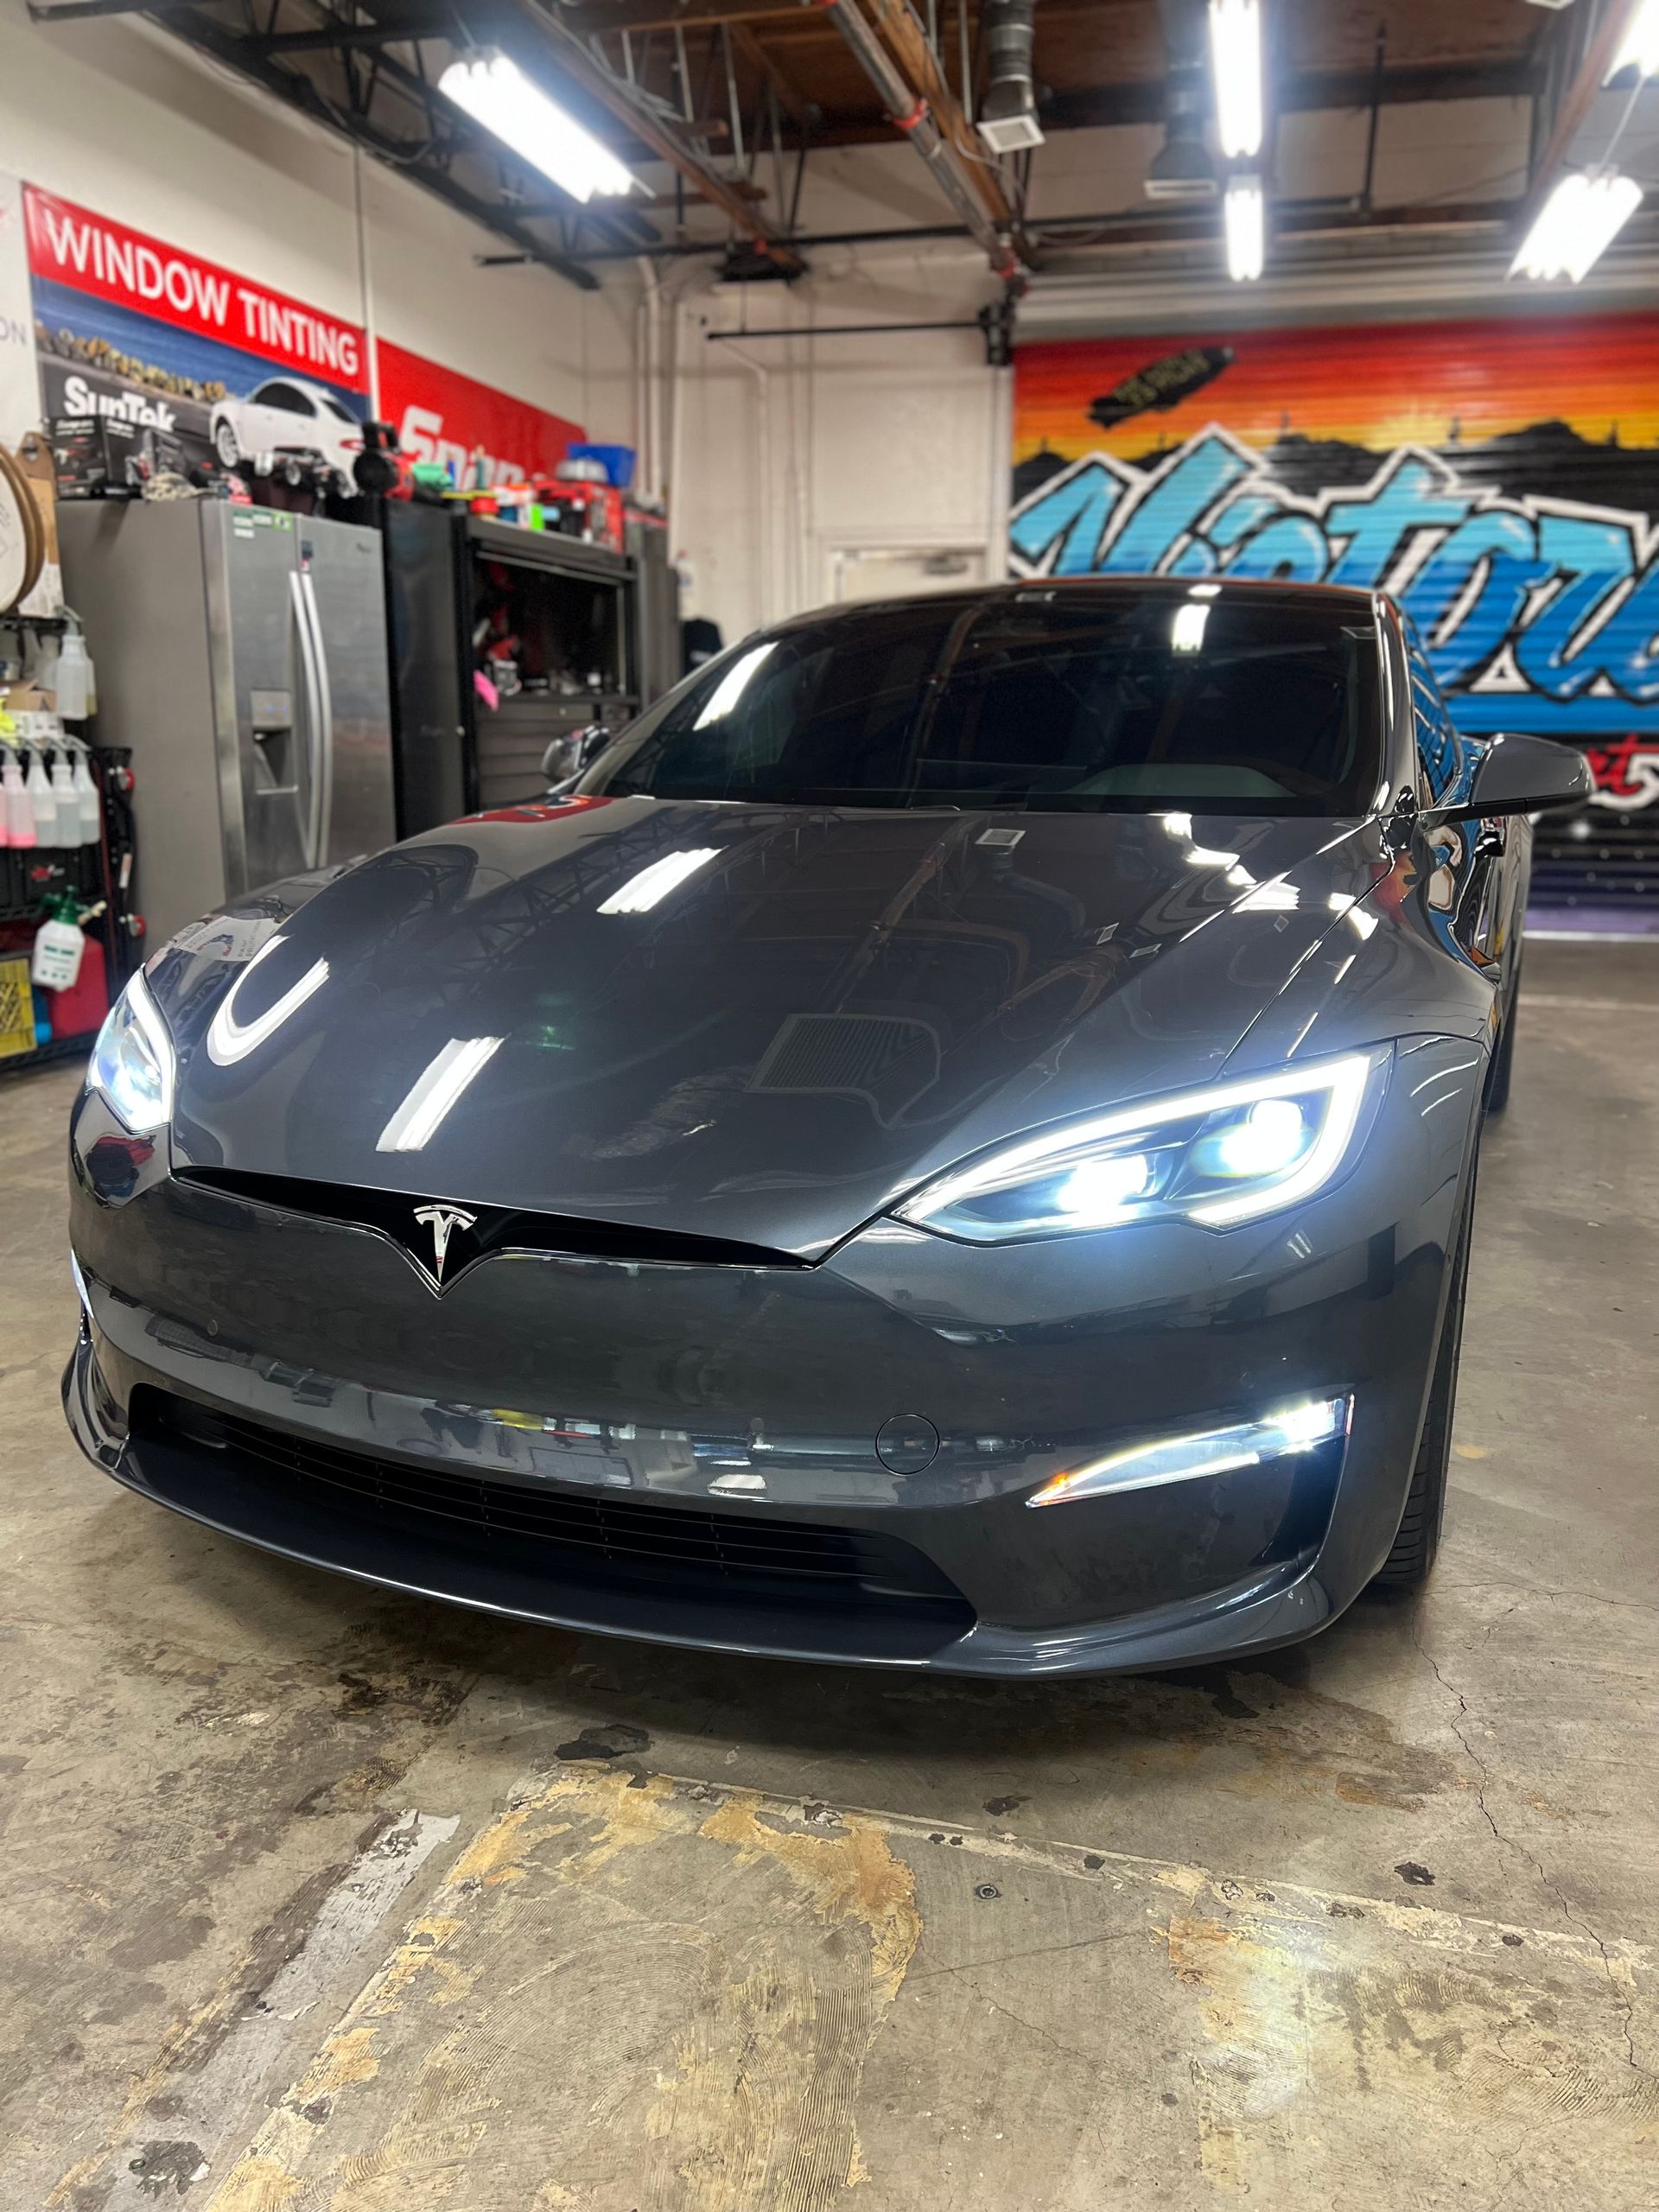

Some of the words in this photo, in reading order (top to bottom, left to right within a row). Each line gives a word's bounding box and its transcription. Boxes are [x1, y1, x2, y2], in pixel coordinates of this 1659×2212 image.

[44, 209, 231, 327] WINDOW
[237, 289, 359, 376] TINTING
[64, 375, 176, 433] SunTek
